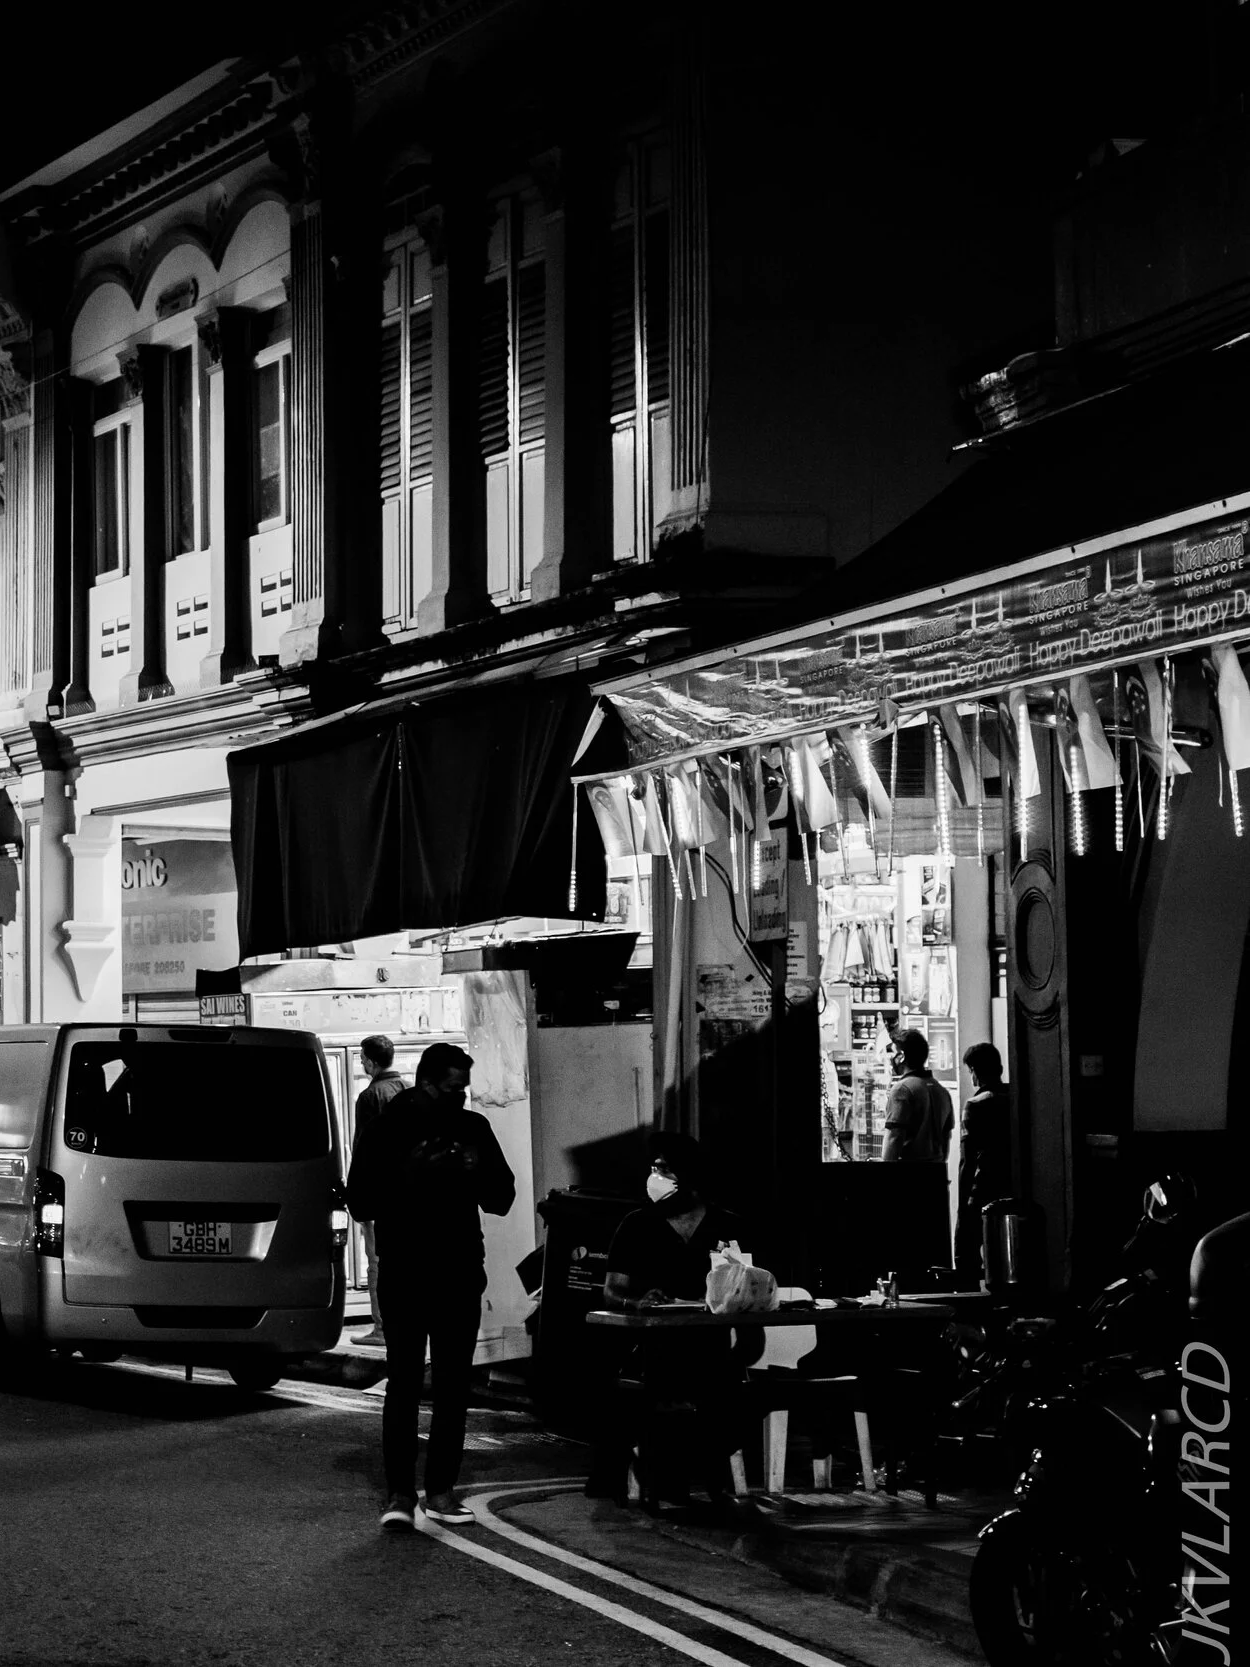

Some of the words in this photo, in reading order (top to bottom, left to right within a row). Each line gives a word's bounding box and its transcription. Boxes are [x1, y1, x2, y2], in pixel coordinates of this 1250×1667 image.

[1174, 559, 1244, 586] SINGAPORE
[1186, 583, 1214, 599] Wishes
[1216, 578, 1232, 590] You
[1029, 600, 1088, 625] SINGAPORE
[1174, 600, 1231, 636] Happy
[1029, 637, 1077, 670] Happy
[800, 667, 843, 684] SINGAPORE
[122, 849, 167, 889] onic
[201, 997, 215, 1016] SAI
[216, 995, 246, 1015] WINES
[69, 1131, 85, 1142] 70
[184, 1222, 217, 1237] GBH
